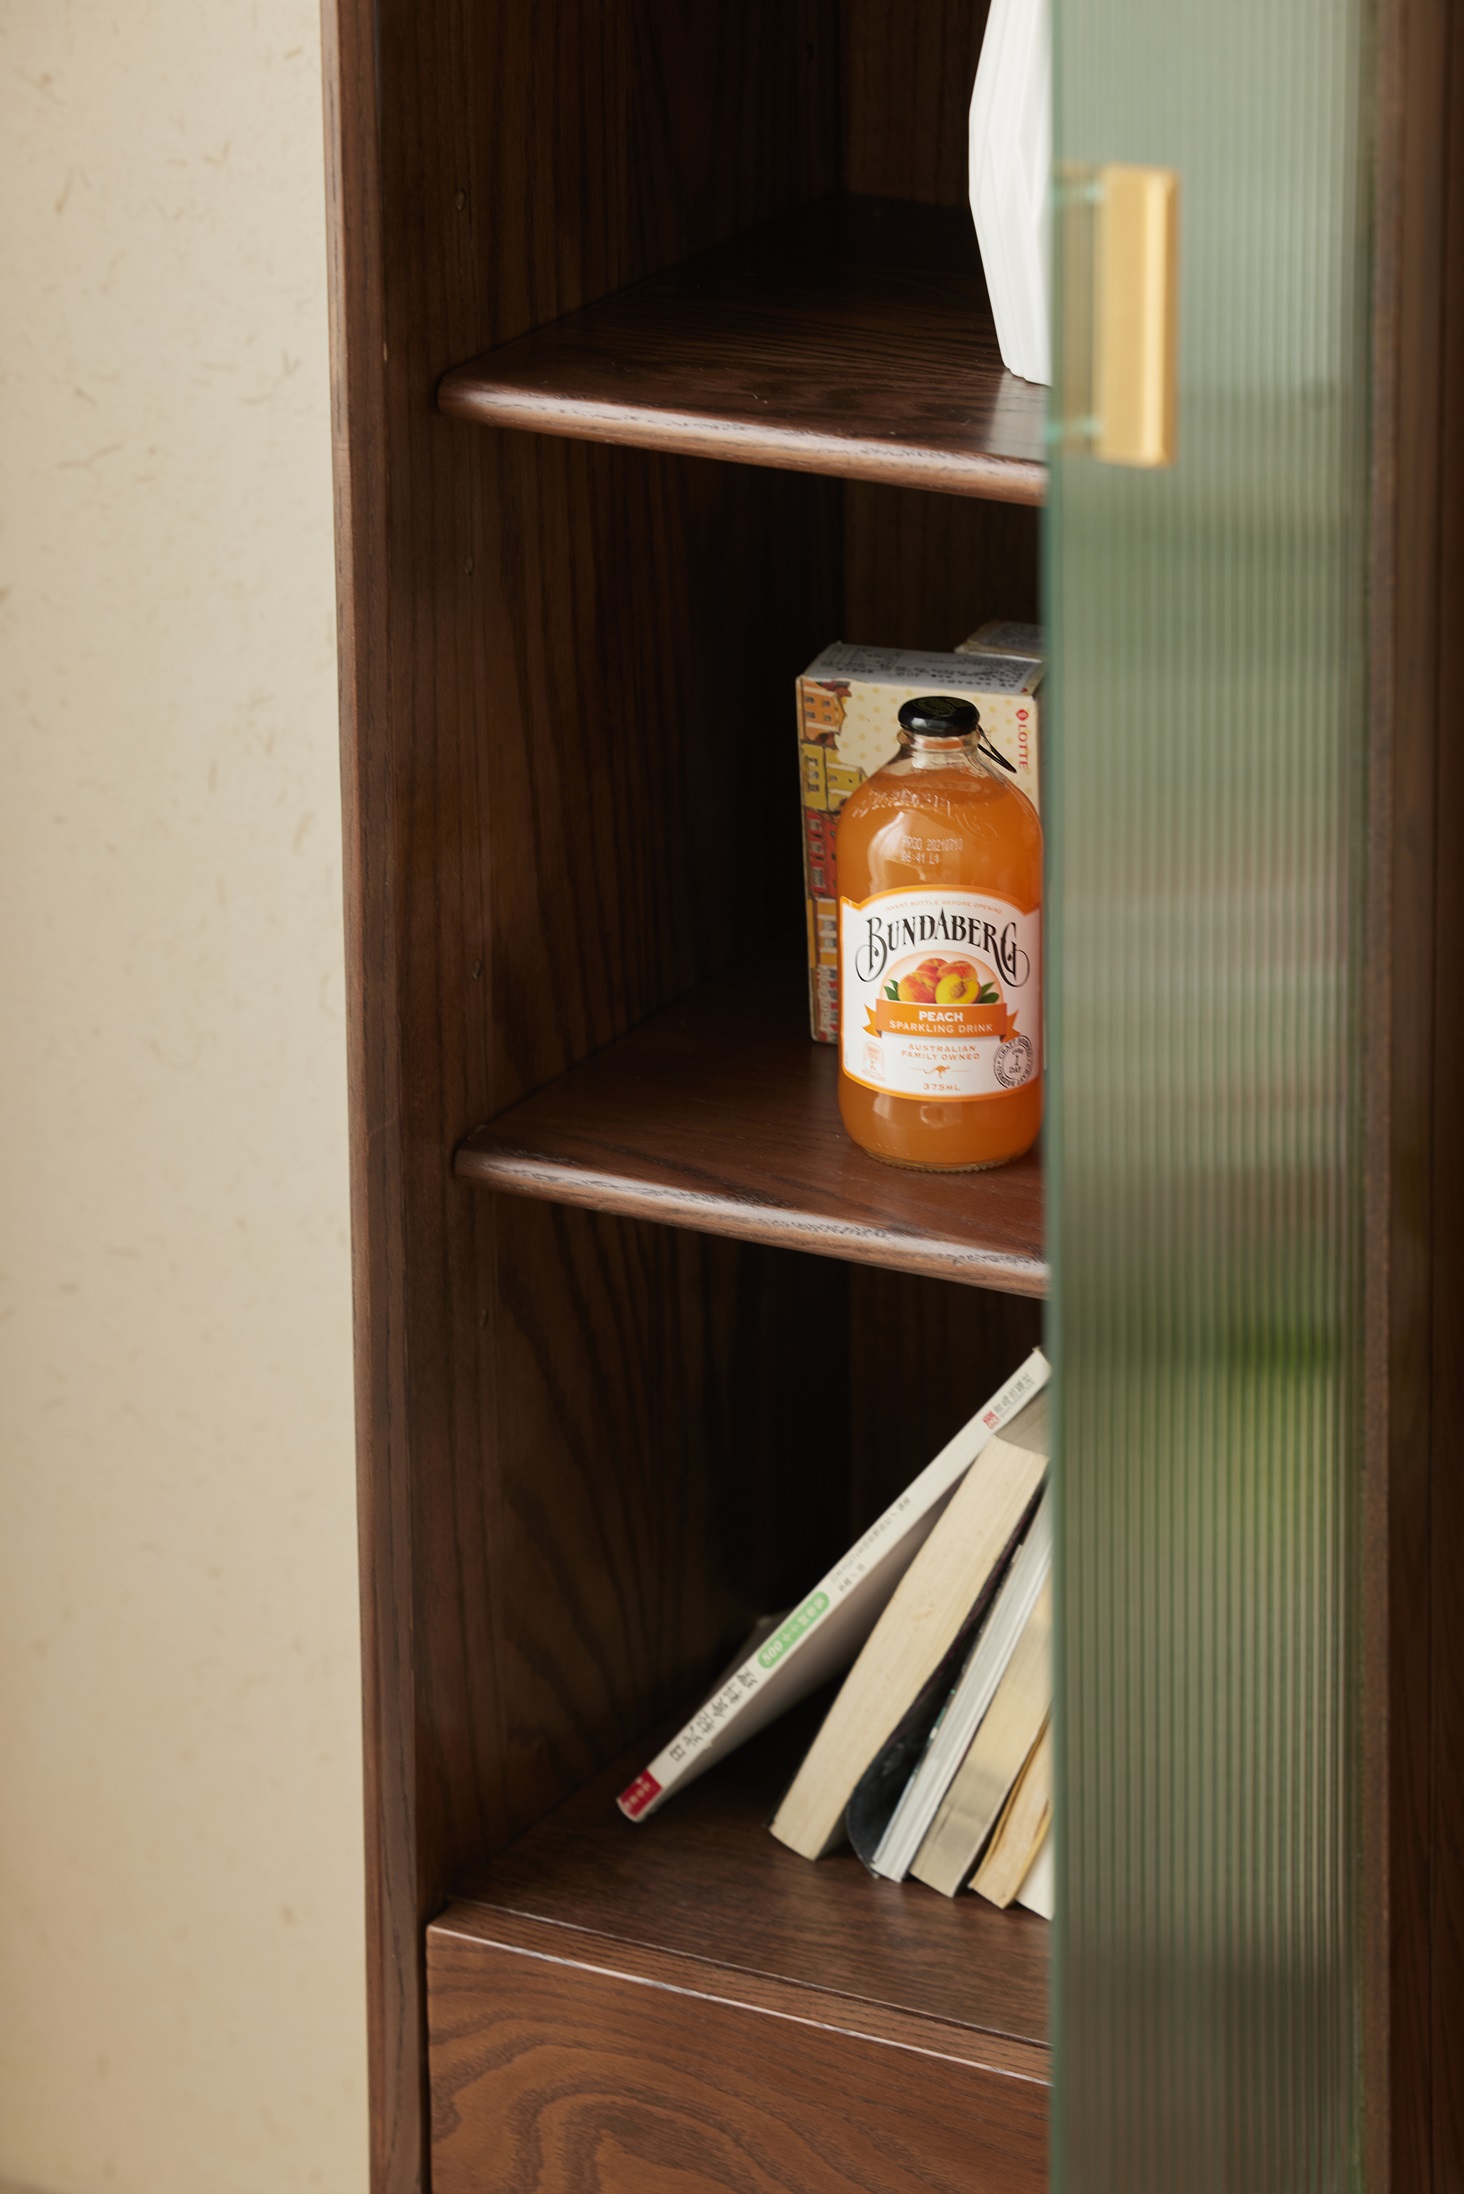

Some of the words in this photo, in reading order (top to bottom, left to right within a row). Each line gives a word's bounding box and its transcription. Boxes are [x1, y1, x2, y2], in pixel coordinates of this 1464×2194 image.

[1017, 725, 1029, 769] LOTTE
[855, 907, 1030, 988] BUNDABERG
[918, 1010, 964, 1022] PEACH
[889, 1020, 954, 1033] SPARKLING
[958, 1023, 993, 1033] DRINK
[908, 1043, 976, 1053] AUSTRALIAN
[901, 1050, 937, 1060] FAMILY
[923, 1082, 961, 1091] 375ML
[669, 1668, 758, 1761] 日式轻食料理
